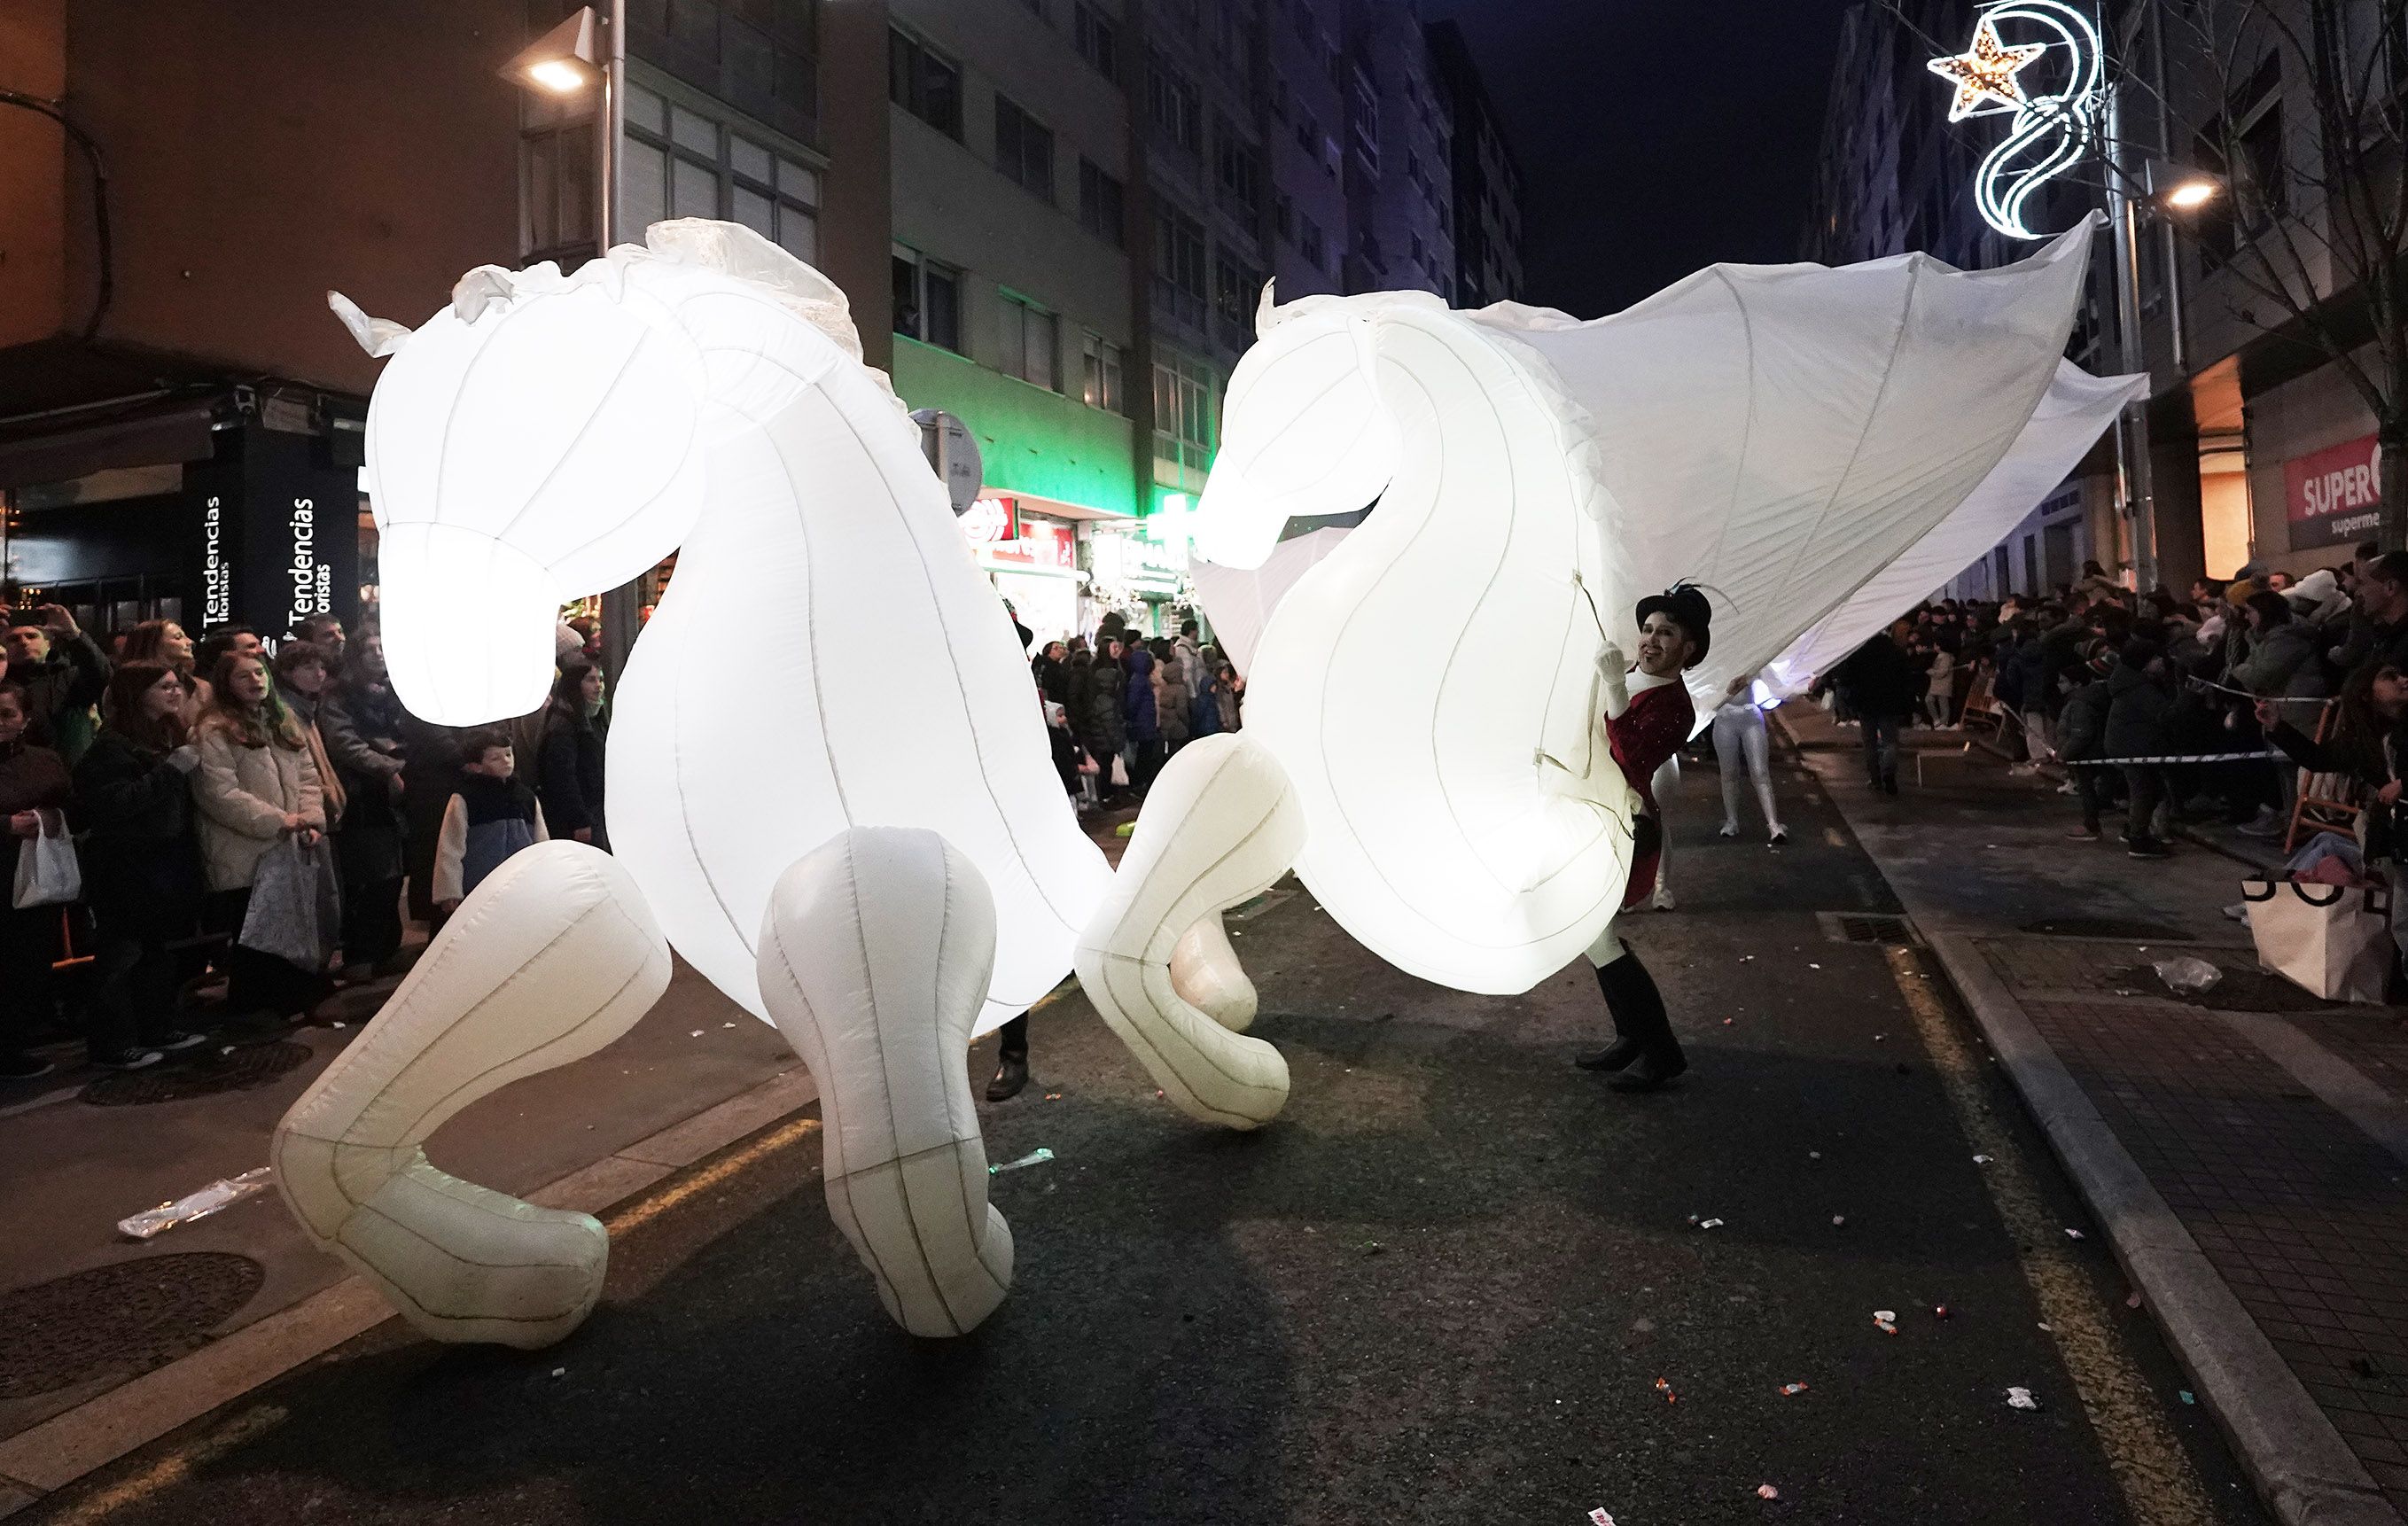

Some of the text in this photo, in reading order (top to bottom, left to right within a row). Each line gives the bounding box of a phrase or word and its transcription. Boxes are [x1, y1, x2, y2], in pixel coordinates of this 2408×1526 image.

[203, 496, 220, 628] Tendencias
[287, 498, 314, 627] Tendencias
[2332, 512, 2380, 537] superme
[314, 564, 331, 614] oristas
